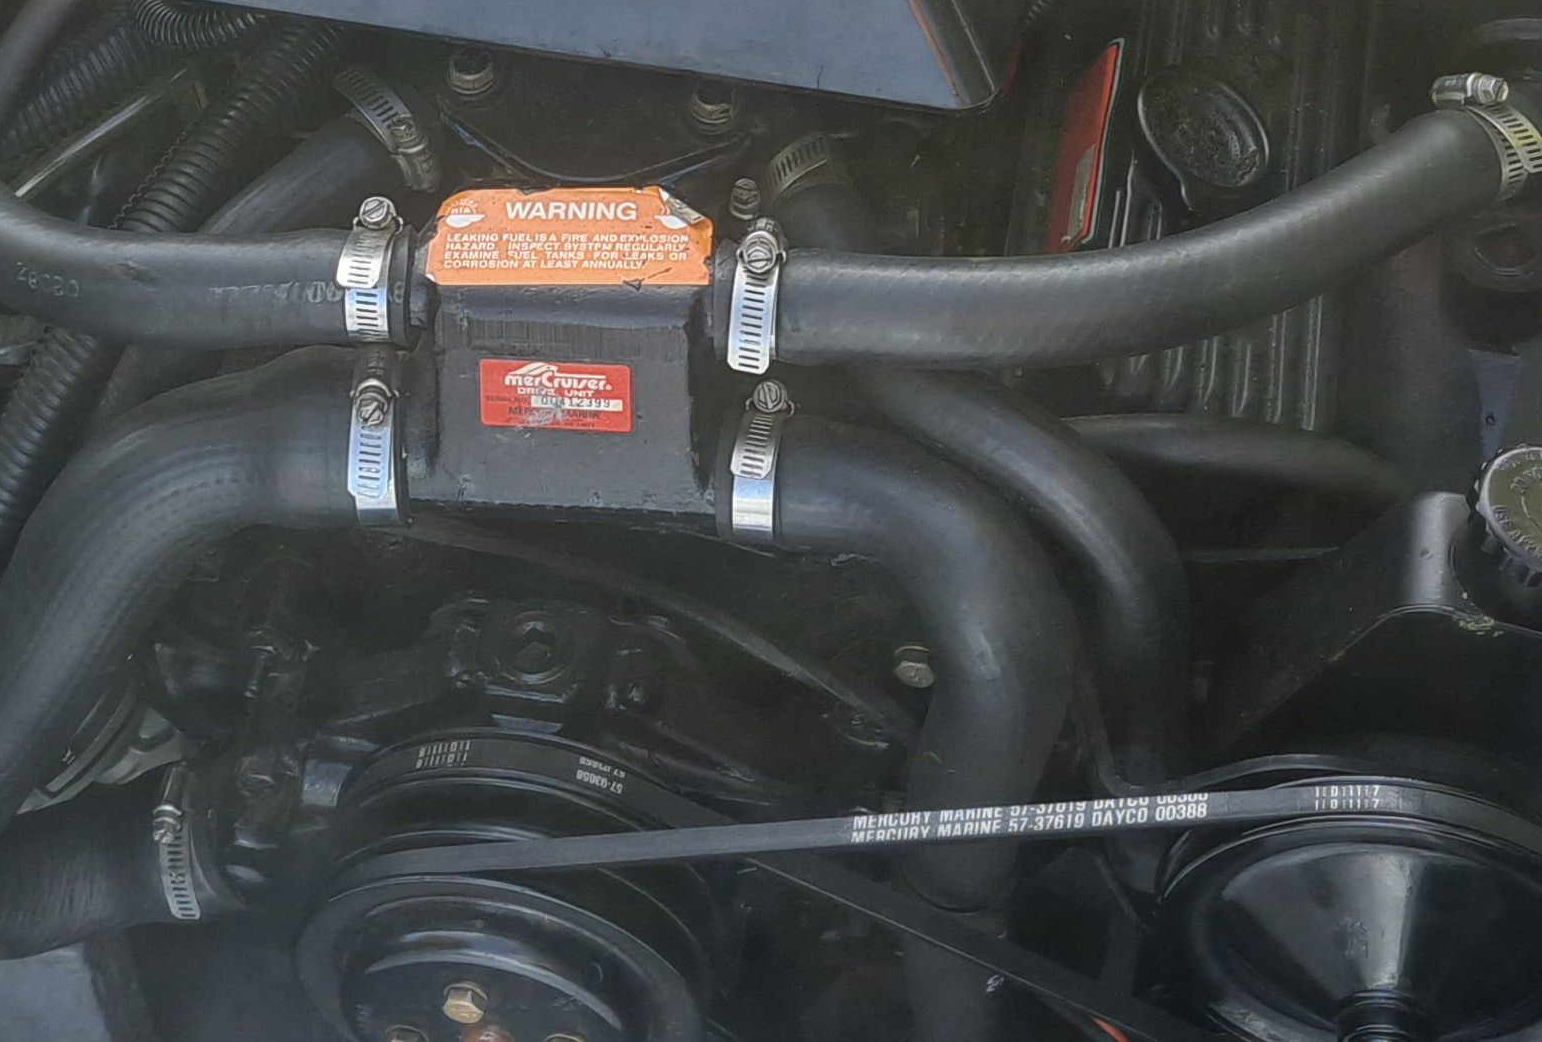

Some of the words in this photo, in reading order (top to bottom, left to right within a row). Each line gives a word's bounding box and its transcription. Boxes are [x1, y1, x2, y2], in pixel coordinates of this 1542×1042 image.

[505, 201, 637, 221] WARNING
[447, 233, 499, 242] LEAKING
[502, 233, 534, 242] FUEL
[535, 233, 547, 242] IS
[561, 233, 588, 242] FIRE
[593, 233, 618, 243] AND
[620, 234, 689, 243] EXPLOSION
[507, 242, 560, 251] INSPECT
[444, 250, 499, 260] EXAMINE
[506, 251, 539, 260] FUEL
[545, 251, 585, 260] TANKS
[593, 252, 619, 260] FOR
[623, 252, 664, 261] LEAKS
[669, 252, 687, 261] OR
[443, 260, 519, 269] CORROSION
[522, 260, 538, 269] AT
[540, 260, 580, 269] LEAST
[517, 386, 556, 396] DRIVE
[564, 389, 595, 398] UNIT
[851, 825, 930, 843] MERCURY
[937, 819, 1001, 838] MARINE
[1008, 813, 1085, 832] 57-37619
[1091, 807, 1148, 827] DAYCO
[1155, 803, 1208, 822] 00388
[853, 811, 931, 830] MERCURY
[939, 807, 1004, 822] MARINE
